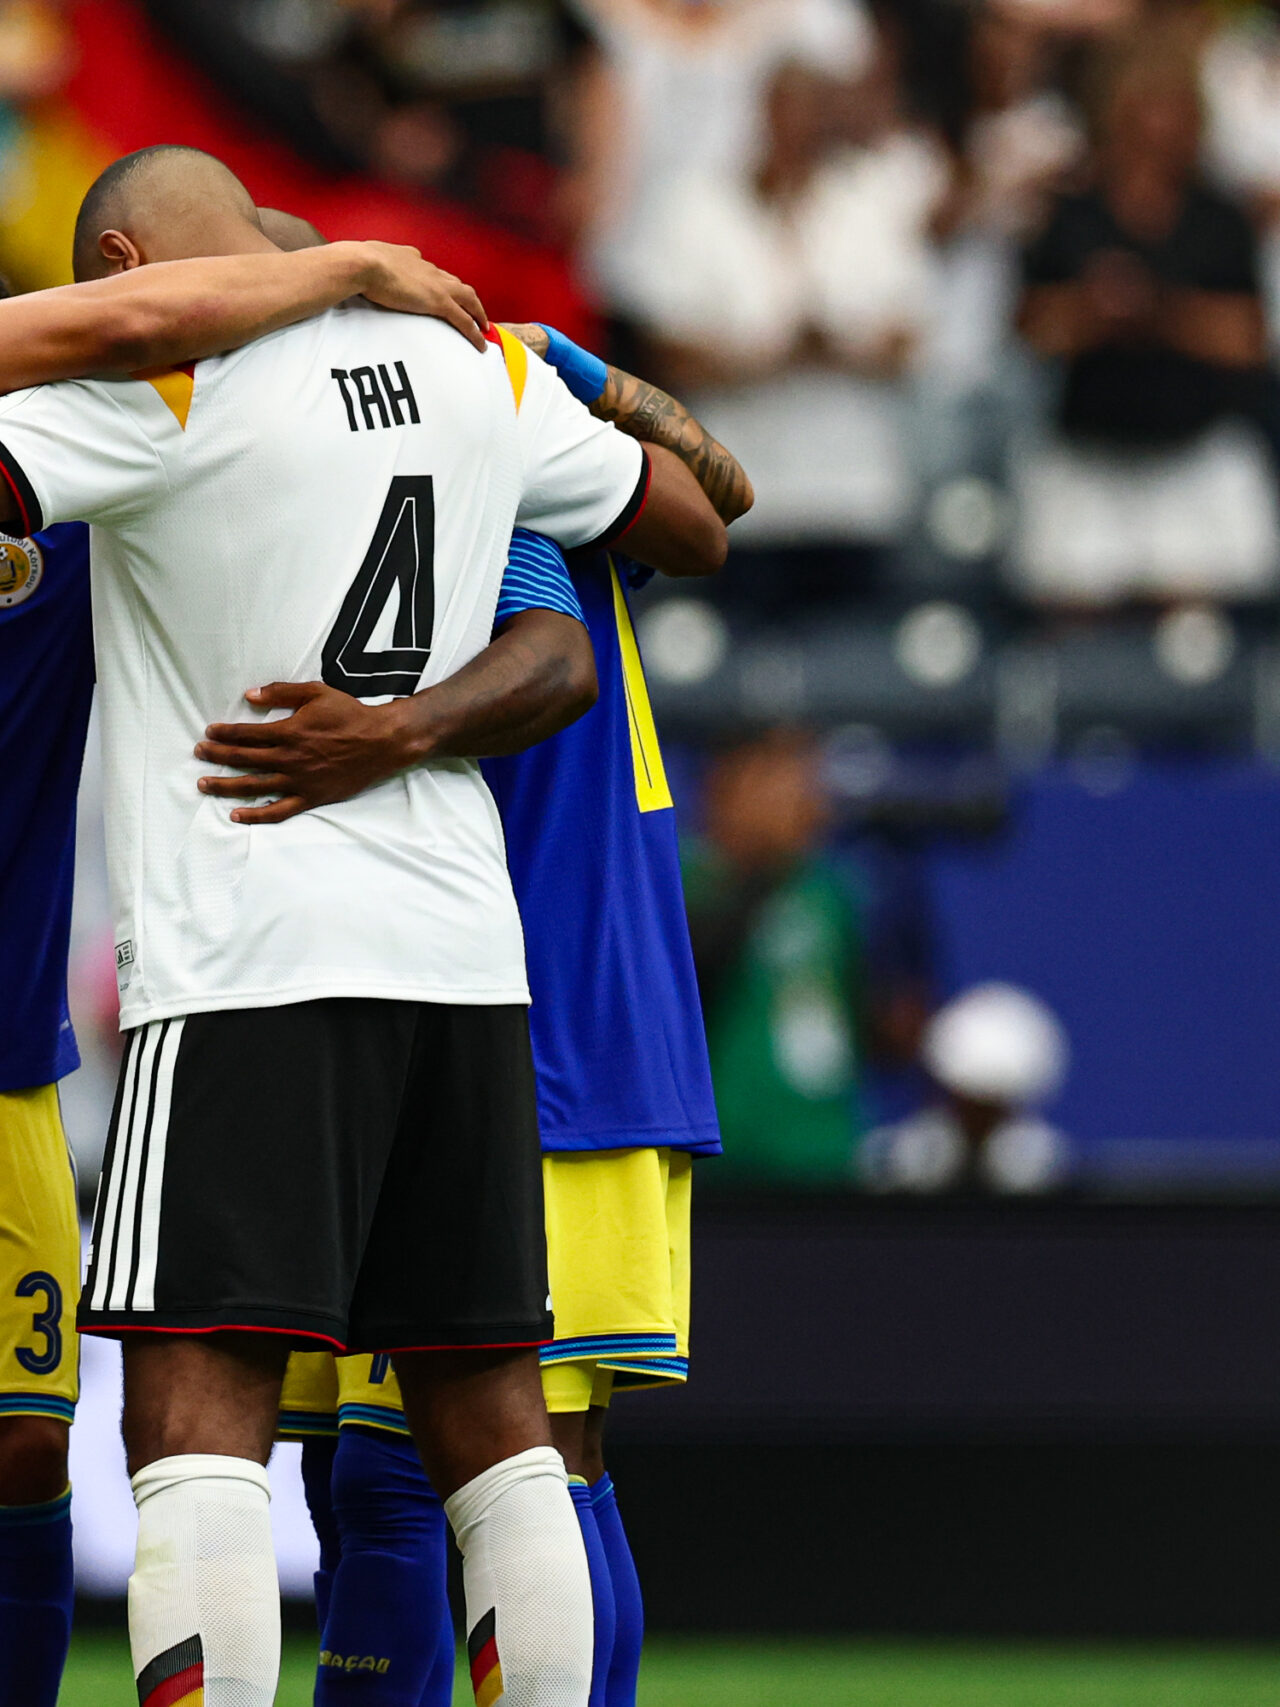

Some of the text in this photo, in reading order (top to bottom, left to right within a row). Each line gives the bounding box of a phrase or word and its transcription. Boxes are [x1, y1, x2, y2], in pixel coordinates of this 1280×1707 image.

[331, 361, 420, 431] TAH
[321, 475, 435, 700] 4
[15, 1270, 63, 1375] 3
